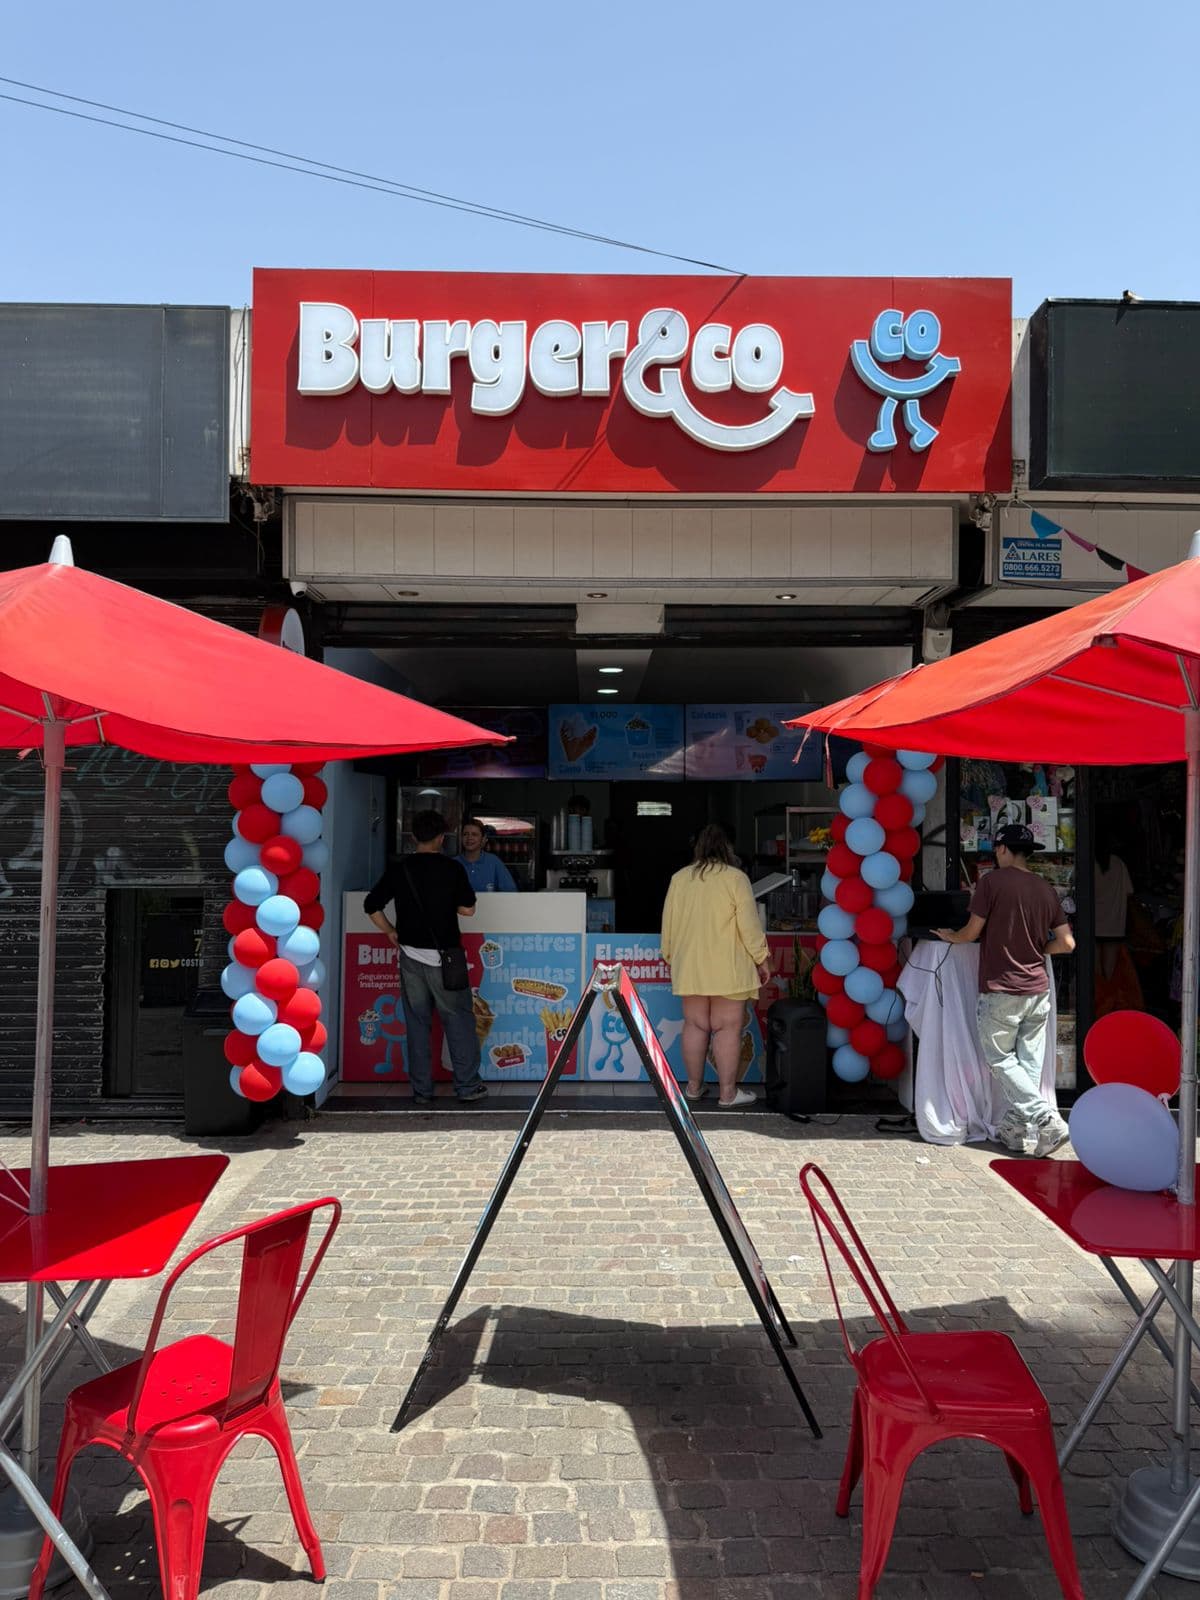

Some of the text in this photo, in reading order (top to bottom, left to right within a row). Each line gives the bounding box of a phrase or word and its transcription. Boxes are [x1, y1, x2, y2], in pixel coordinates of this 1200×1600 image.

[595, 944, 663, 960] El sabor
[490, 963, 576, 984] minutas
